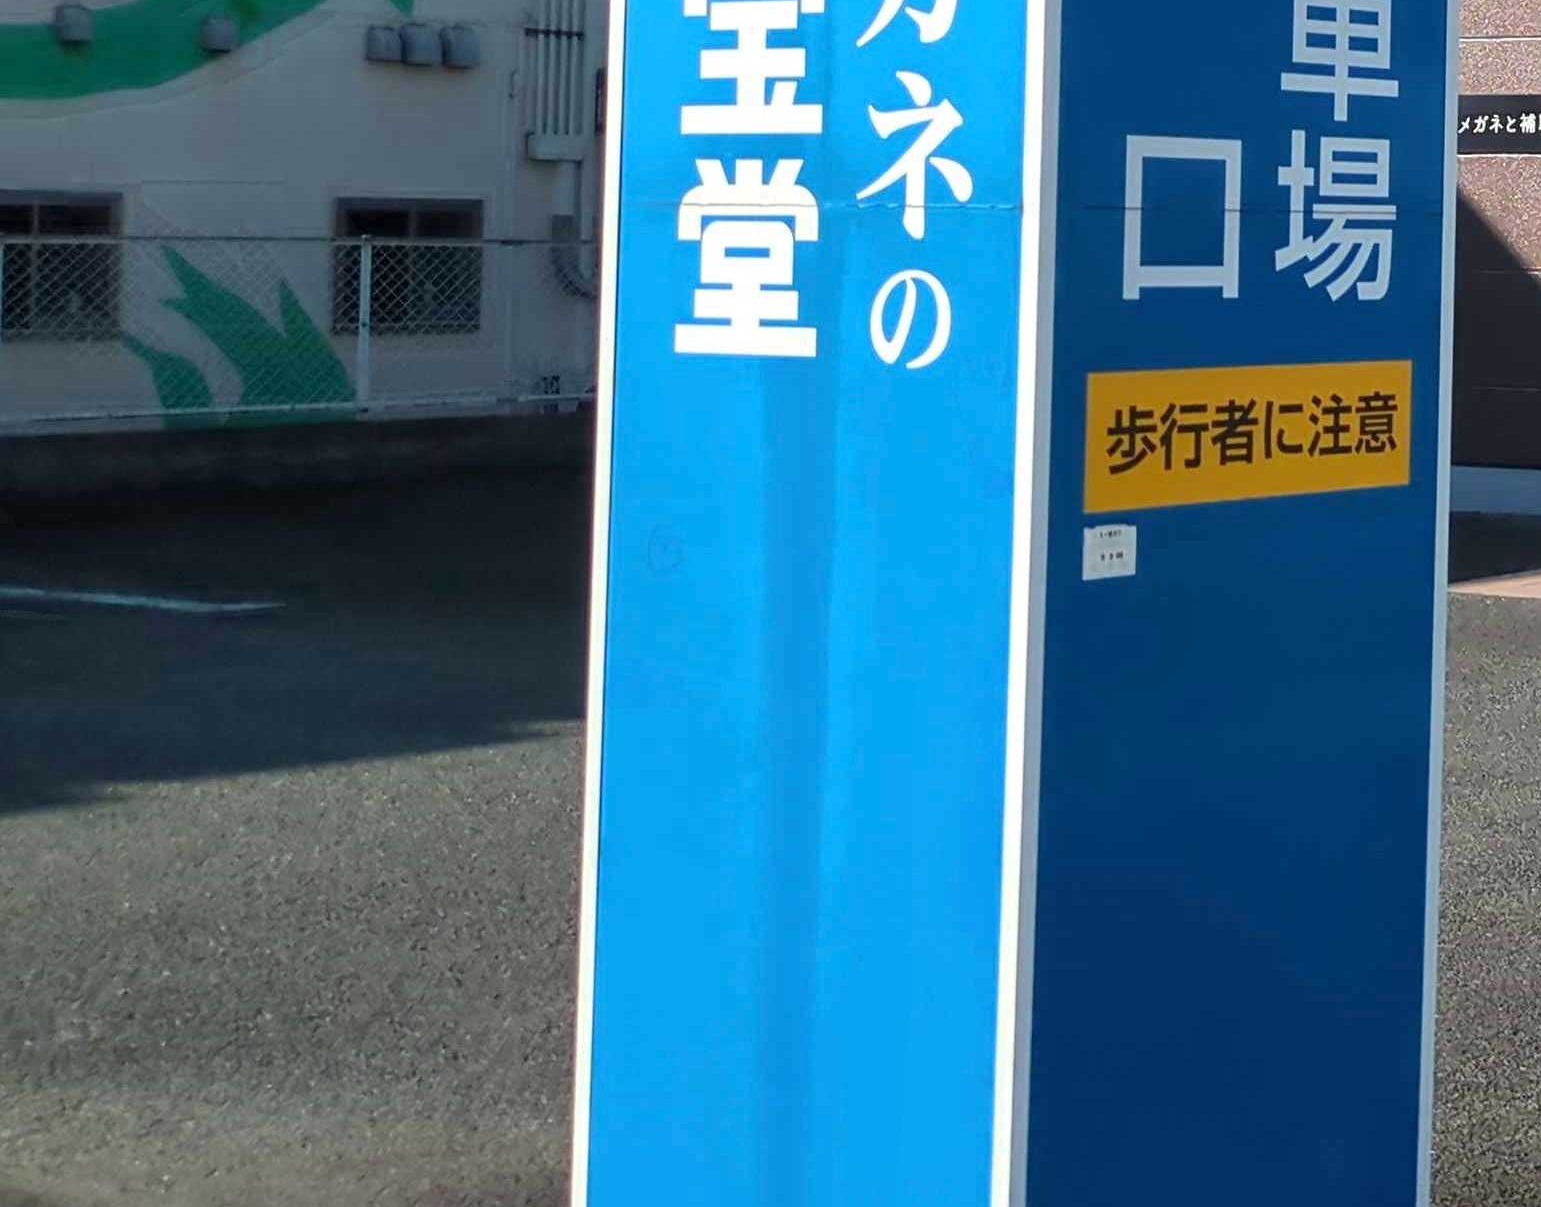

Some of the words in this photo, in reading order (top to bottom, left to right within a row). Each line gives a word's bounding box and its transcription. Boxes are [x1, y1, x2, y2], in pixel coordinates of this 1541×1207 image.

[1106, 391, 1400, 474] 歩行者に注意
